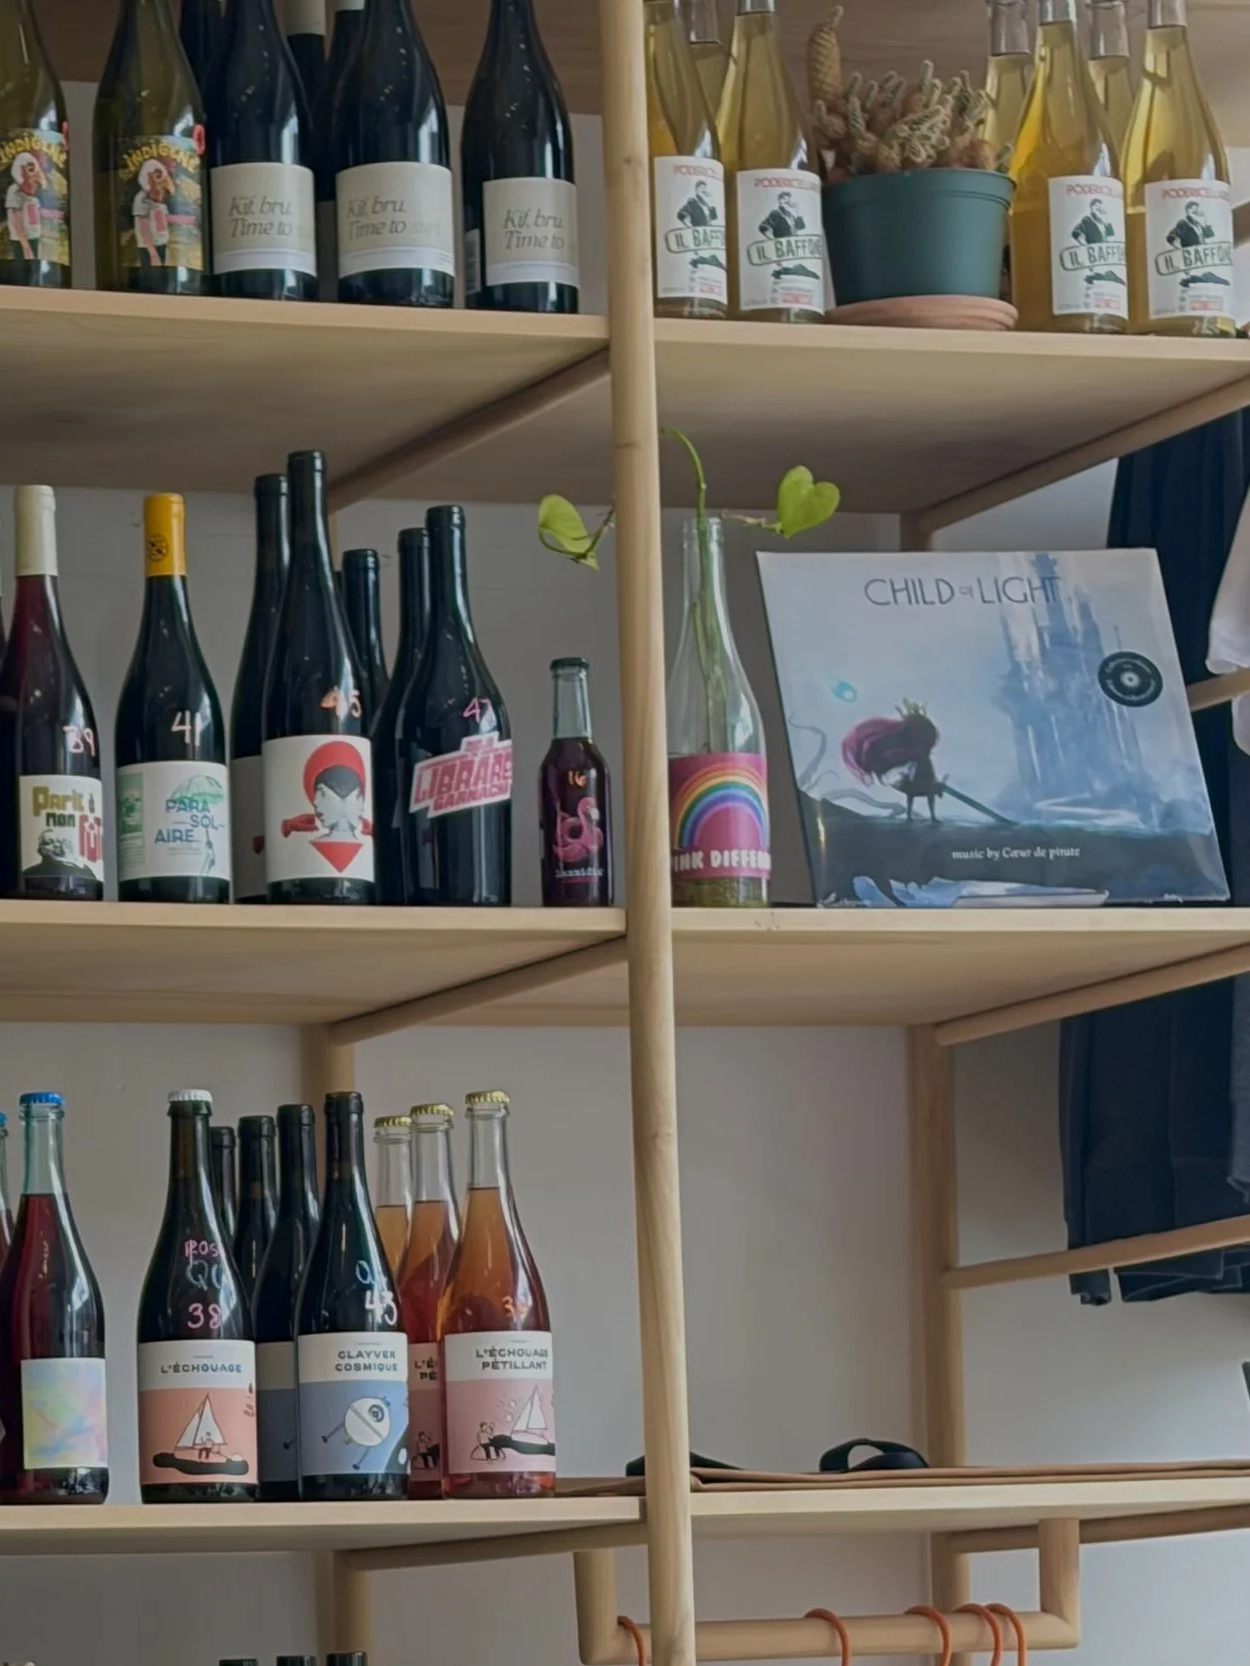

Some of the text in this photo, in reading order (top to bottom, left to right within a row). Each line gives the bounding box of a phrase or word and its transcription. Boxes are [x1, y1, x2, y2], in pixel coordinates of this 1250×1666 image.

[230, 219, 293, 238] Time to
[347, 220, 385, 240] Time
[390, 220, 407, 234] to
[504, 230, 566, 249] Time to
[675, 234, 689, 249] IL
[756, 246, 771, 260] IL
[1069, 251, 1083, 266] IL
[1165, 256, 1177, 271] IL
[864, 578, 955, 606] CHILD
[977, 576, 1061, 604] LIGHT
[171, 710, 201, 746] 41
[165, 799, 210, 813] PARA
[154, 828, 198, 844] AIRE
[674, 850, 704, 872] INK
[951, 848, 984, 860] music
[986, 847, 999, 861] by
[1033, 846, 1047, 858] de
[1048, 847, 1080, 861] pirate
[187, 1303, 223, 1329] 38
[338, 1349, 396, 1360] CLAYVER
[475, 1346, 548, 1359] L'ÉCHOUAGE
[161, 1361, 242, 1374] L'ÉCHOUAGE
[335, 1361, 398, 1373] COSMIQUE
[481, 1357, 546, 1371] PÉTILLANT
